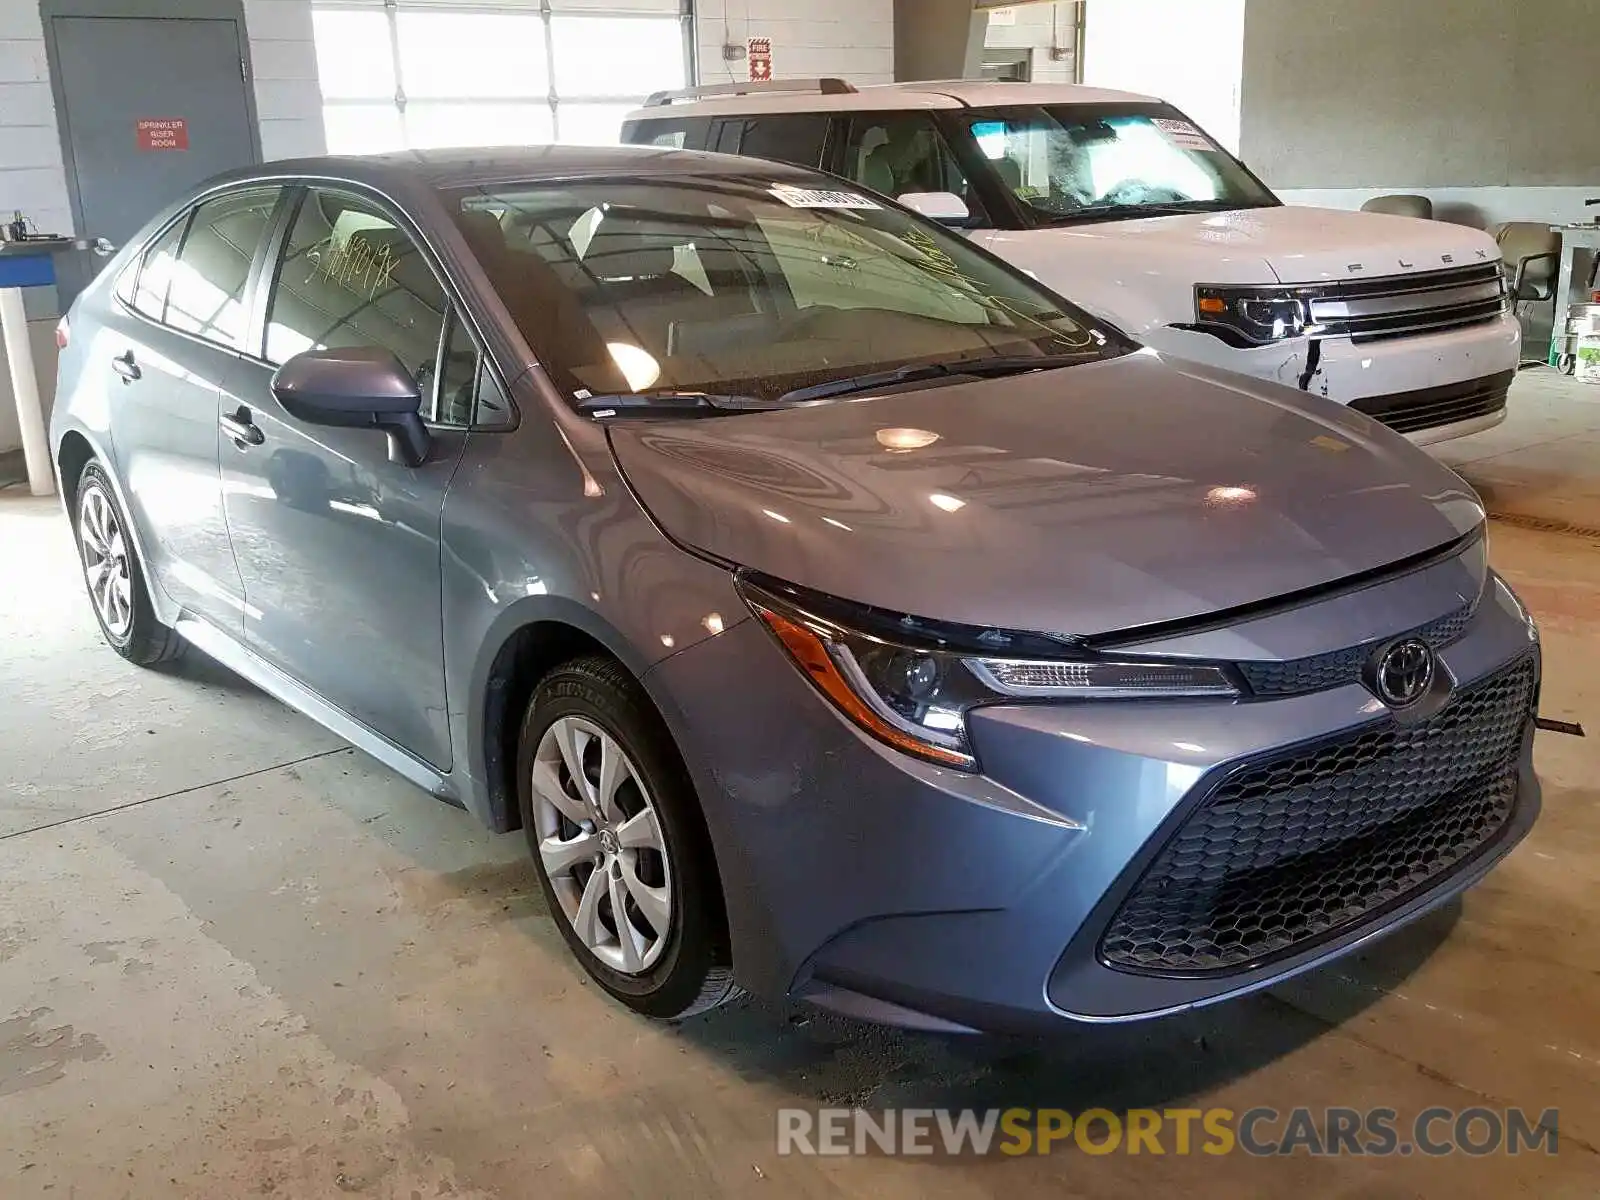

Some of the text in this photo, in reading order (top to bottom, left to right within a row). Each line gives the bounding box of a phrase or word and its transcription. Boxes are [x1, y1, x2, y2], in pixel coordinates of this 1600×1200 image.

[138, 120, 183, 129] SPRINKLER
[150, 130, 174, 138] RISER
[1347, 249, 1486, 273] FLEX
